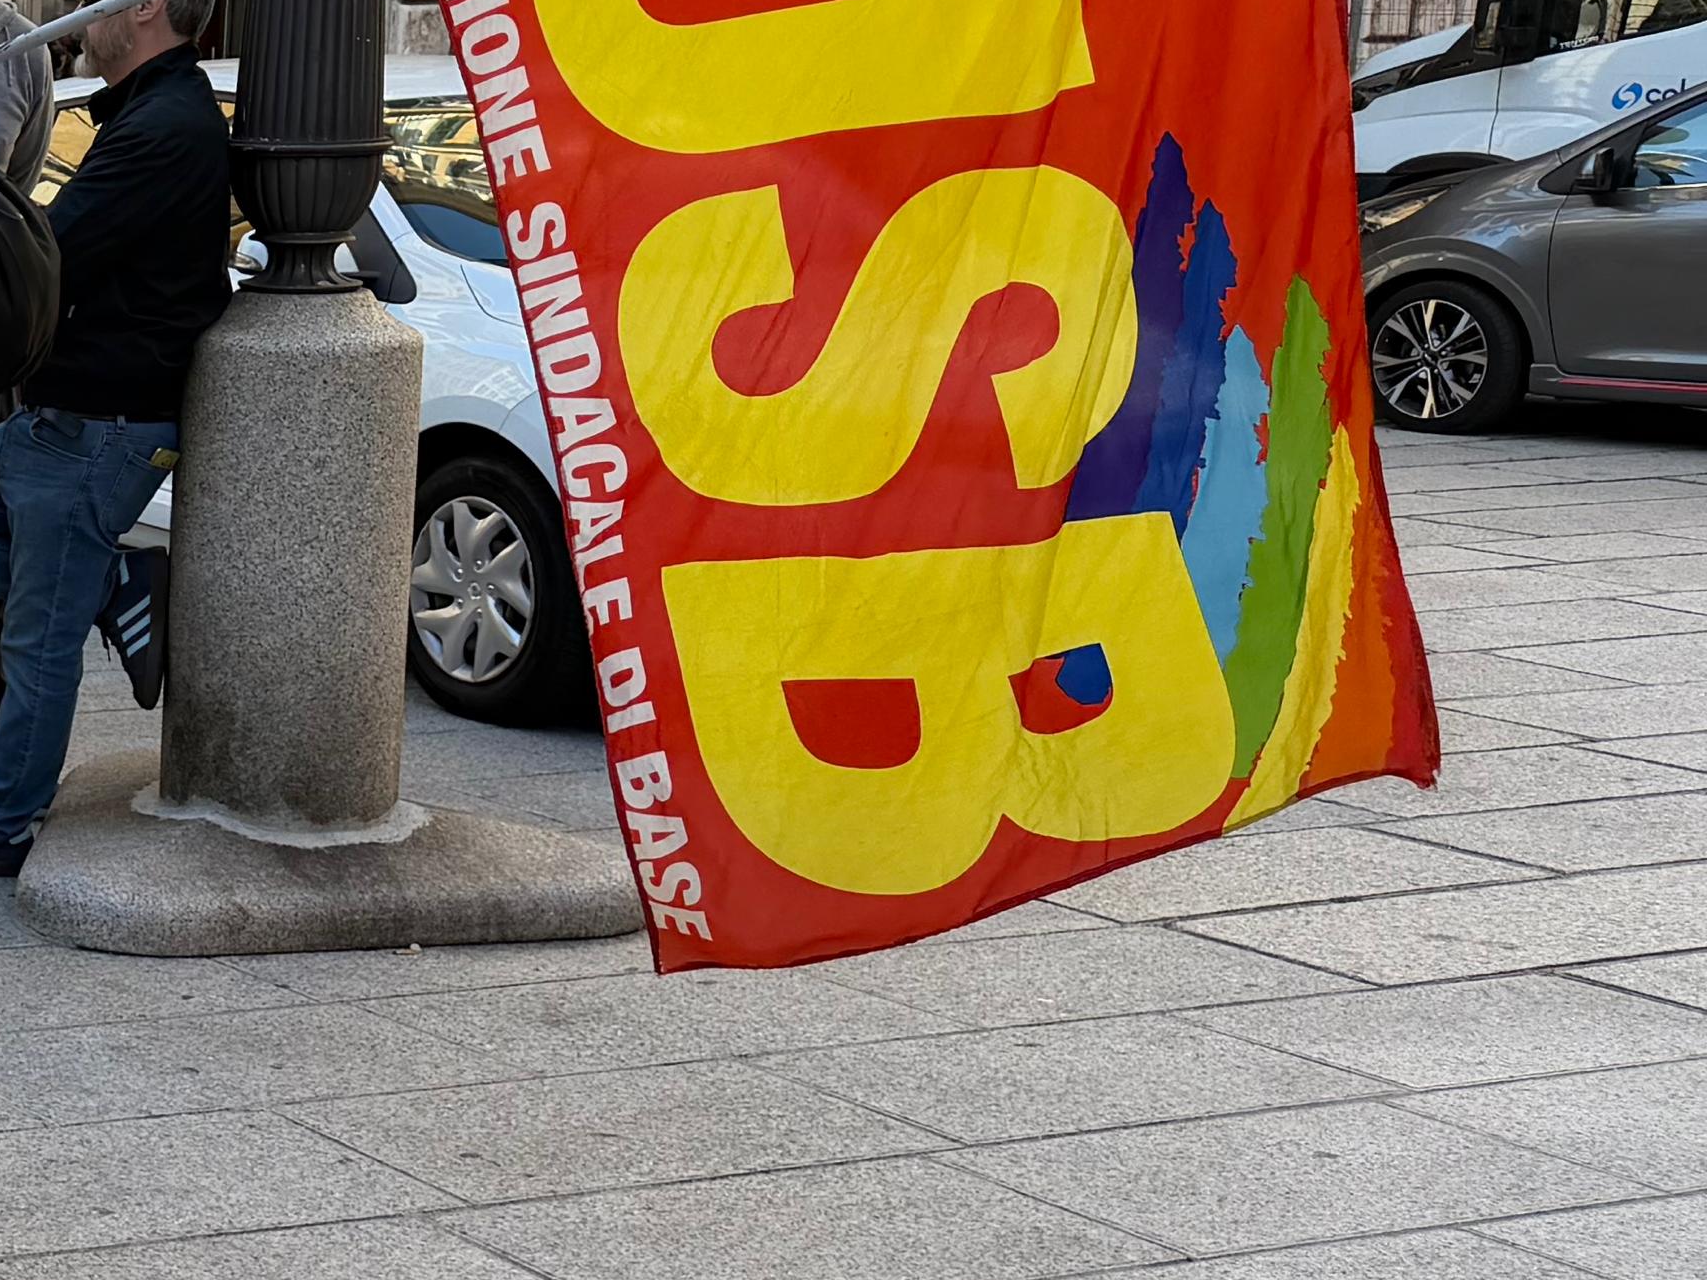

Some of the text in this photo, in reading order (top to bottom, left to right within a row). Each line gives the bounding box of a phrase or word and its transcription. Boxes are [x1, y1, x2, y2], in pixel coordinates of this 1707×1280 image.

[506, 201, 634, 638] SINDACALE
[597, 646, 657, 734] DI
[615, 751, 713, 942] BASE
